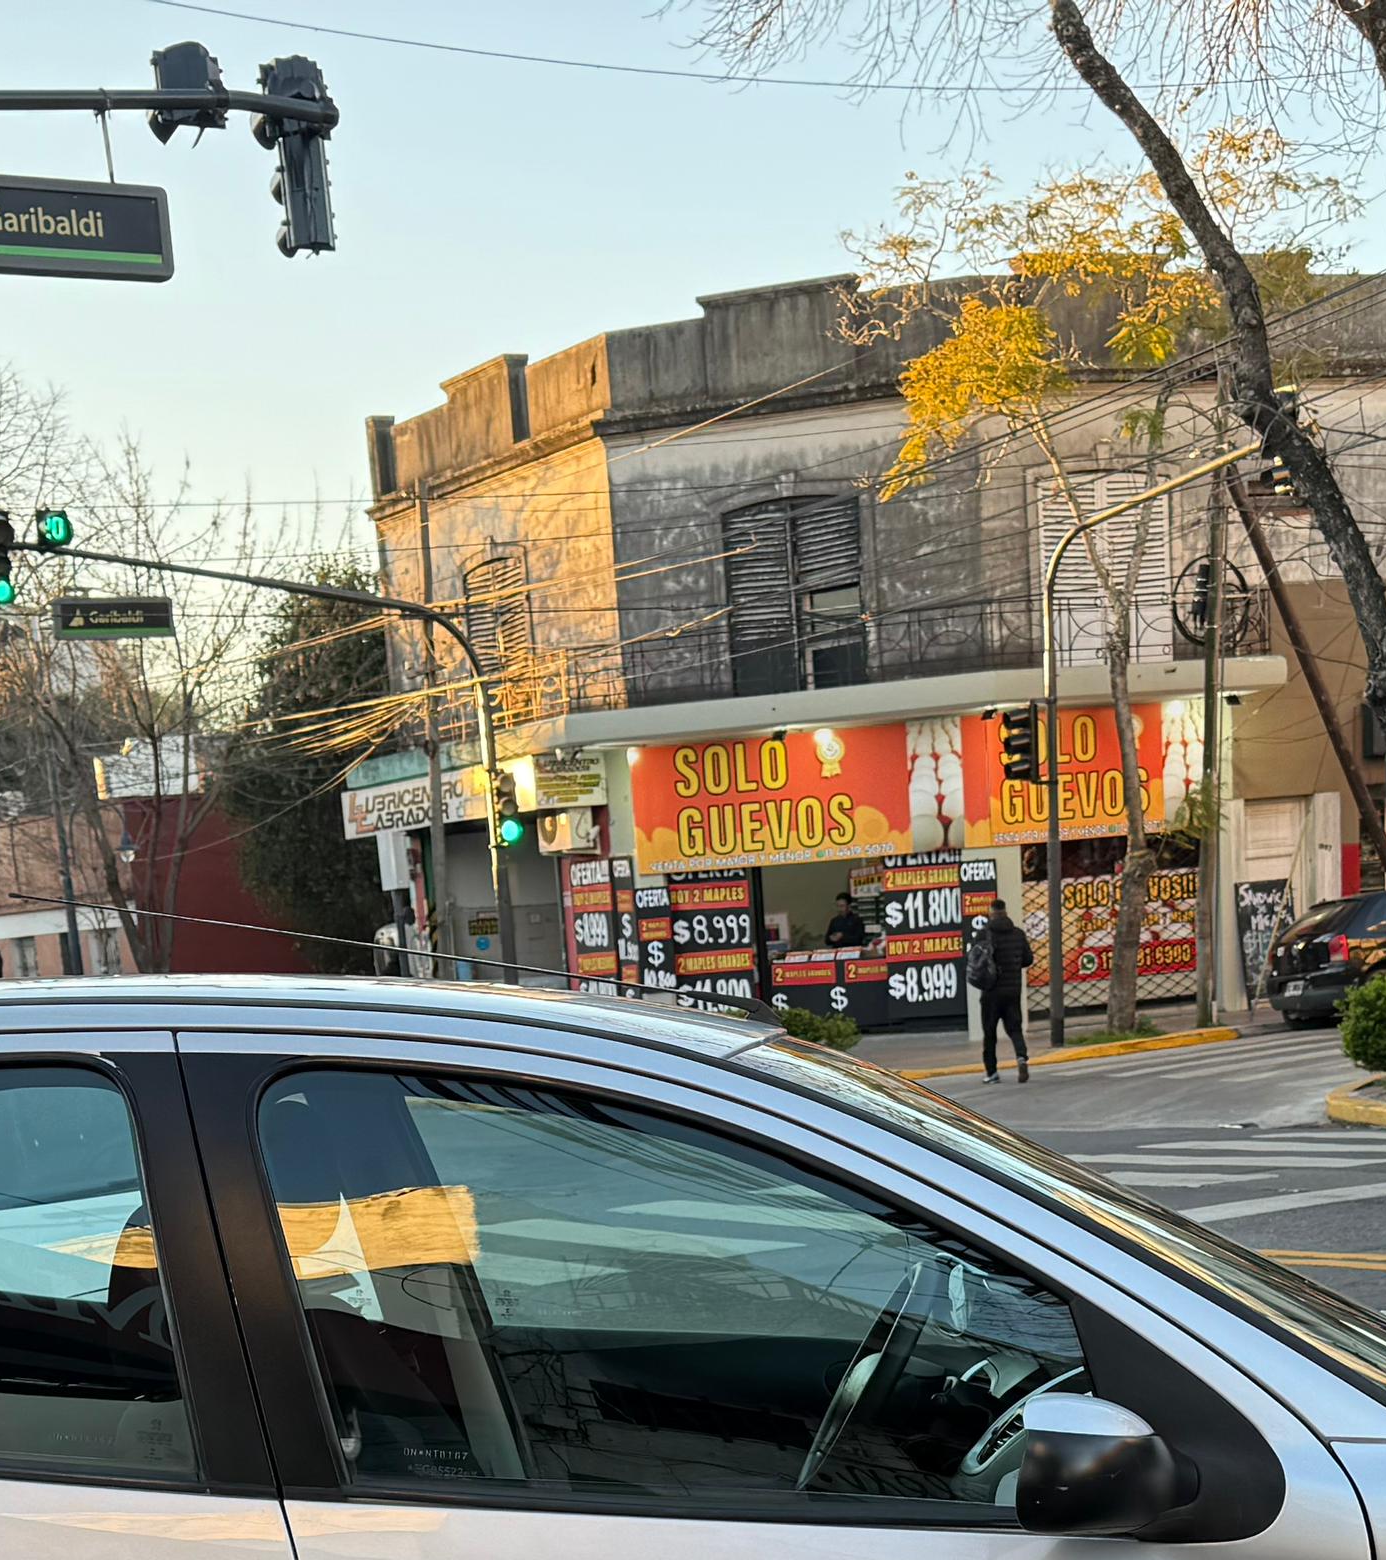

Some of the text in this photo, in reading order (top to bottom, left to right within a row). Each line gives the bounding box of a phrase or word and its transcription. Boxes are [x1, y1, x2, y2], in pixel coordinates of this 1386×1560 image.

[89, 609, 144, 624] Garibaldi
[674, 739, 789, 798] SOLO
[349, 776, 464, 824] LUBRICENRO
[677, 793, 856, 858] GUEVOS
[886, 871, 894, 888] 2
[895, 869, 926, 886] MAPLES
[960, 861, 996, 881] OFERTA
[635, 888, 670, 909] OFERTA
[670, 886, 745, 905] HOY 2 MAPLES
[1063, 880, 1110, 910] SOLO
[885, 887, 962, 929] $11.800
[673, 914, 751, 945] $8.999
[647, 940, 665, 967] $
[888, 940, 908, 956] HOY
[912, 939, 920, 953] 2
[678, 957, 686, 974] 2
[686, 955, 716, 972] MAPLES
[775, 967, 783, 982] 2
[848, 963, 856, 978] 2
[888, 962, 958, 1003] $8.999
[830, 986, 848, 1012] $
